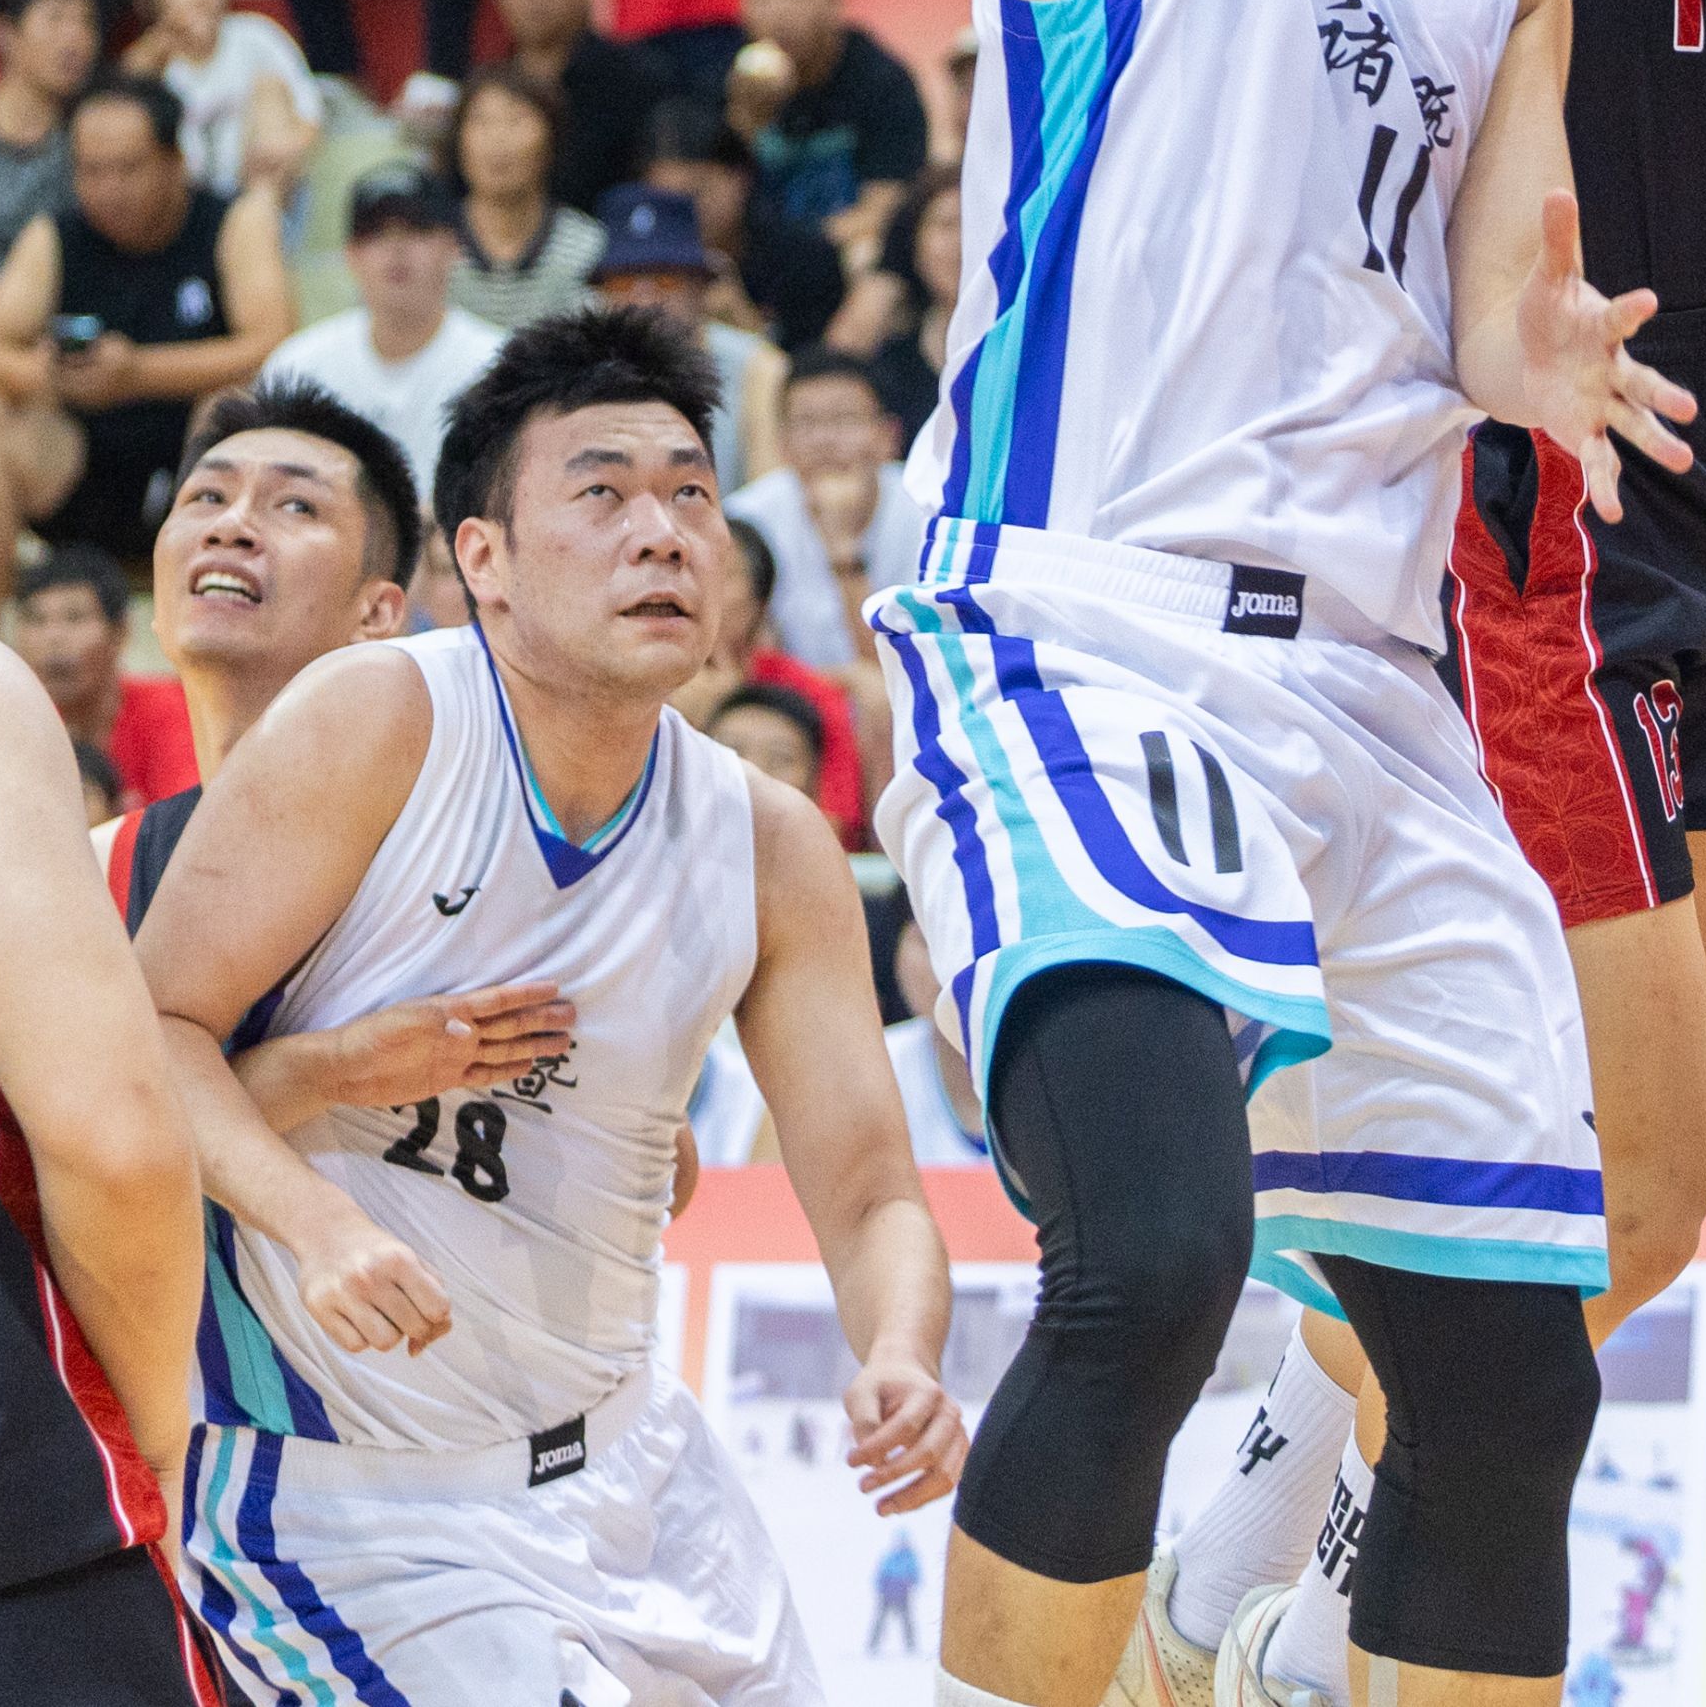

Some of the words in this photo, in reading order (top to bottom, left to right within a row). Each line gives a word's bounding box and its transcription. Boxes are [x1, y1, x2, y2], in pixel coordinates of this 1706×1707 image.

[1356, 123, 1431, 294] 11
[1138, 730, 1244, 874] 11
[1633, 679, 1684, 823] 13
[382, 1095, 511, 1203] 28
